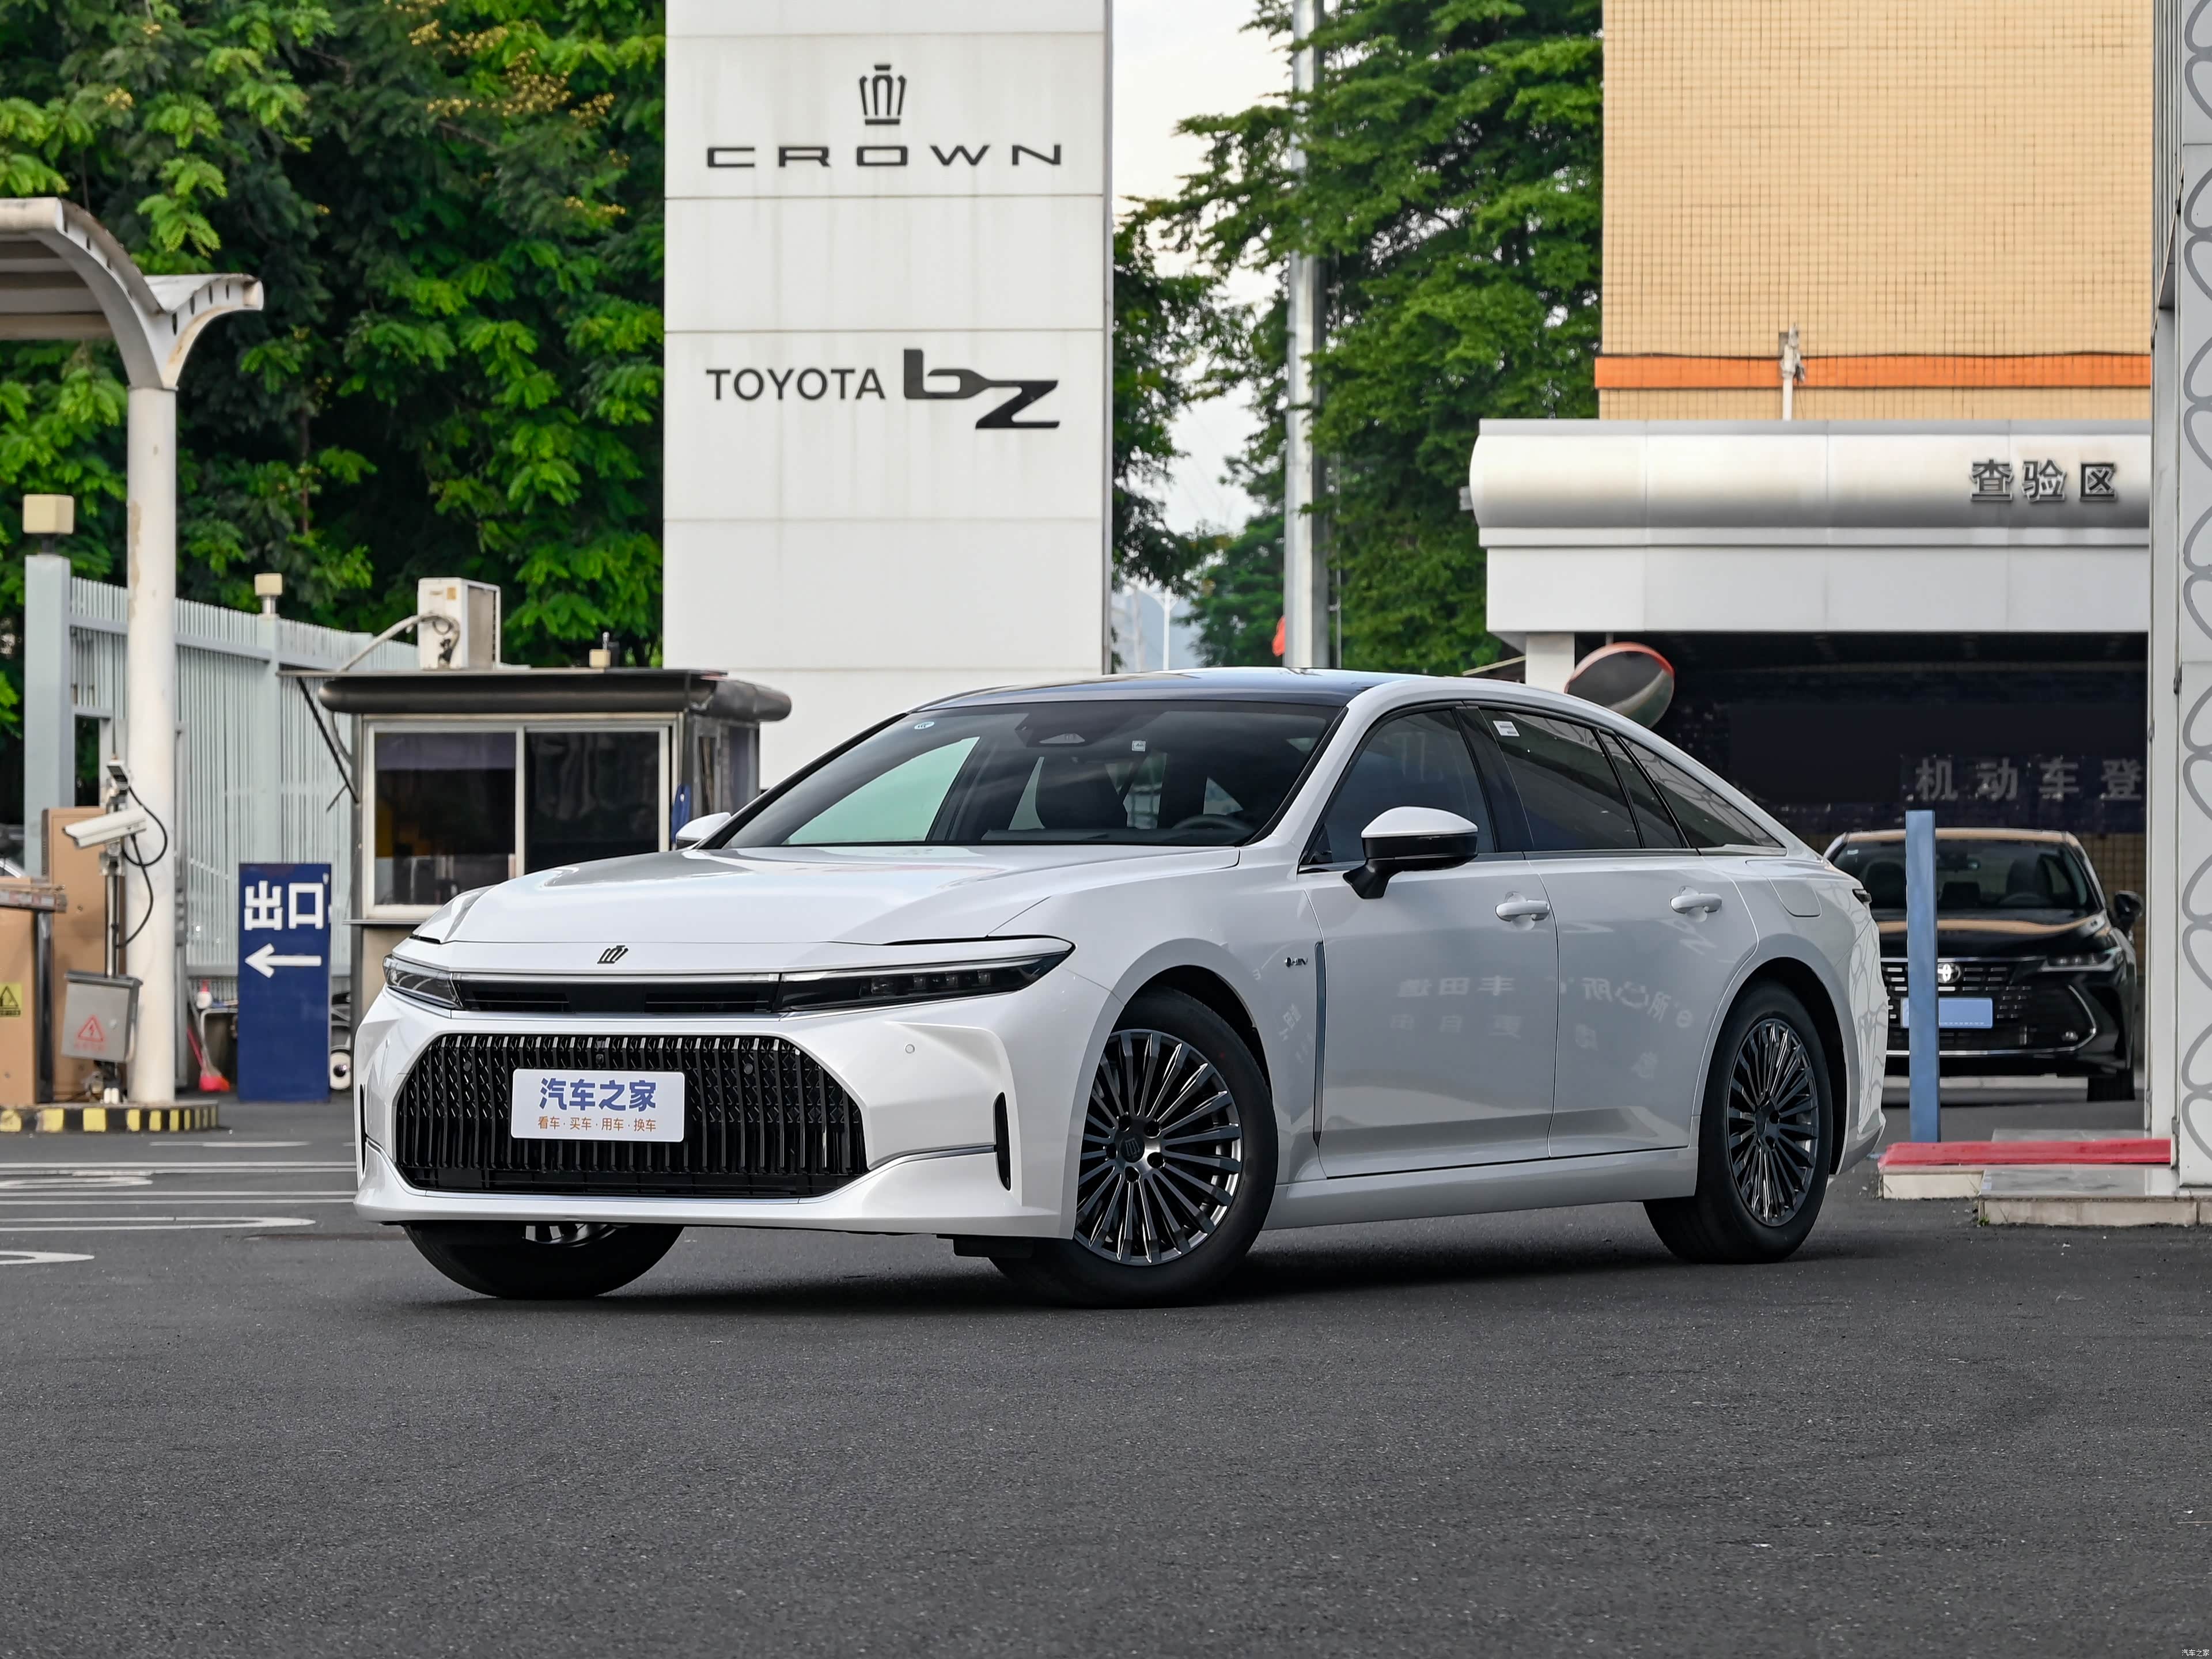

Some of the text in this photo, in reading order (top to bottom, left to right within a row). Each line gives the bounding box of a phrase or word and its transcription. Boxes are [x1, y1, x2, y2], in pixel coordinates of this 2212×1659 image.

[707, 144, 1062, 168] CROWN
[706, 368, 886, 400] TOYOTA
[1969, 459, 2117, 502] 查验区
[244, 880, 325, 931] 出口
[539, 1077, 657, 1112] 汽车之家
